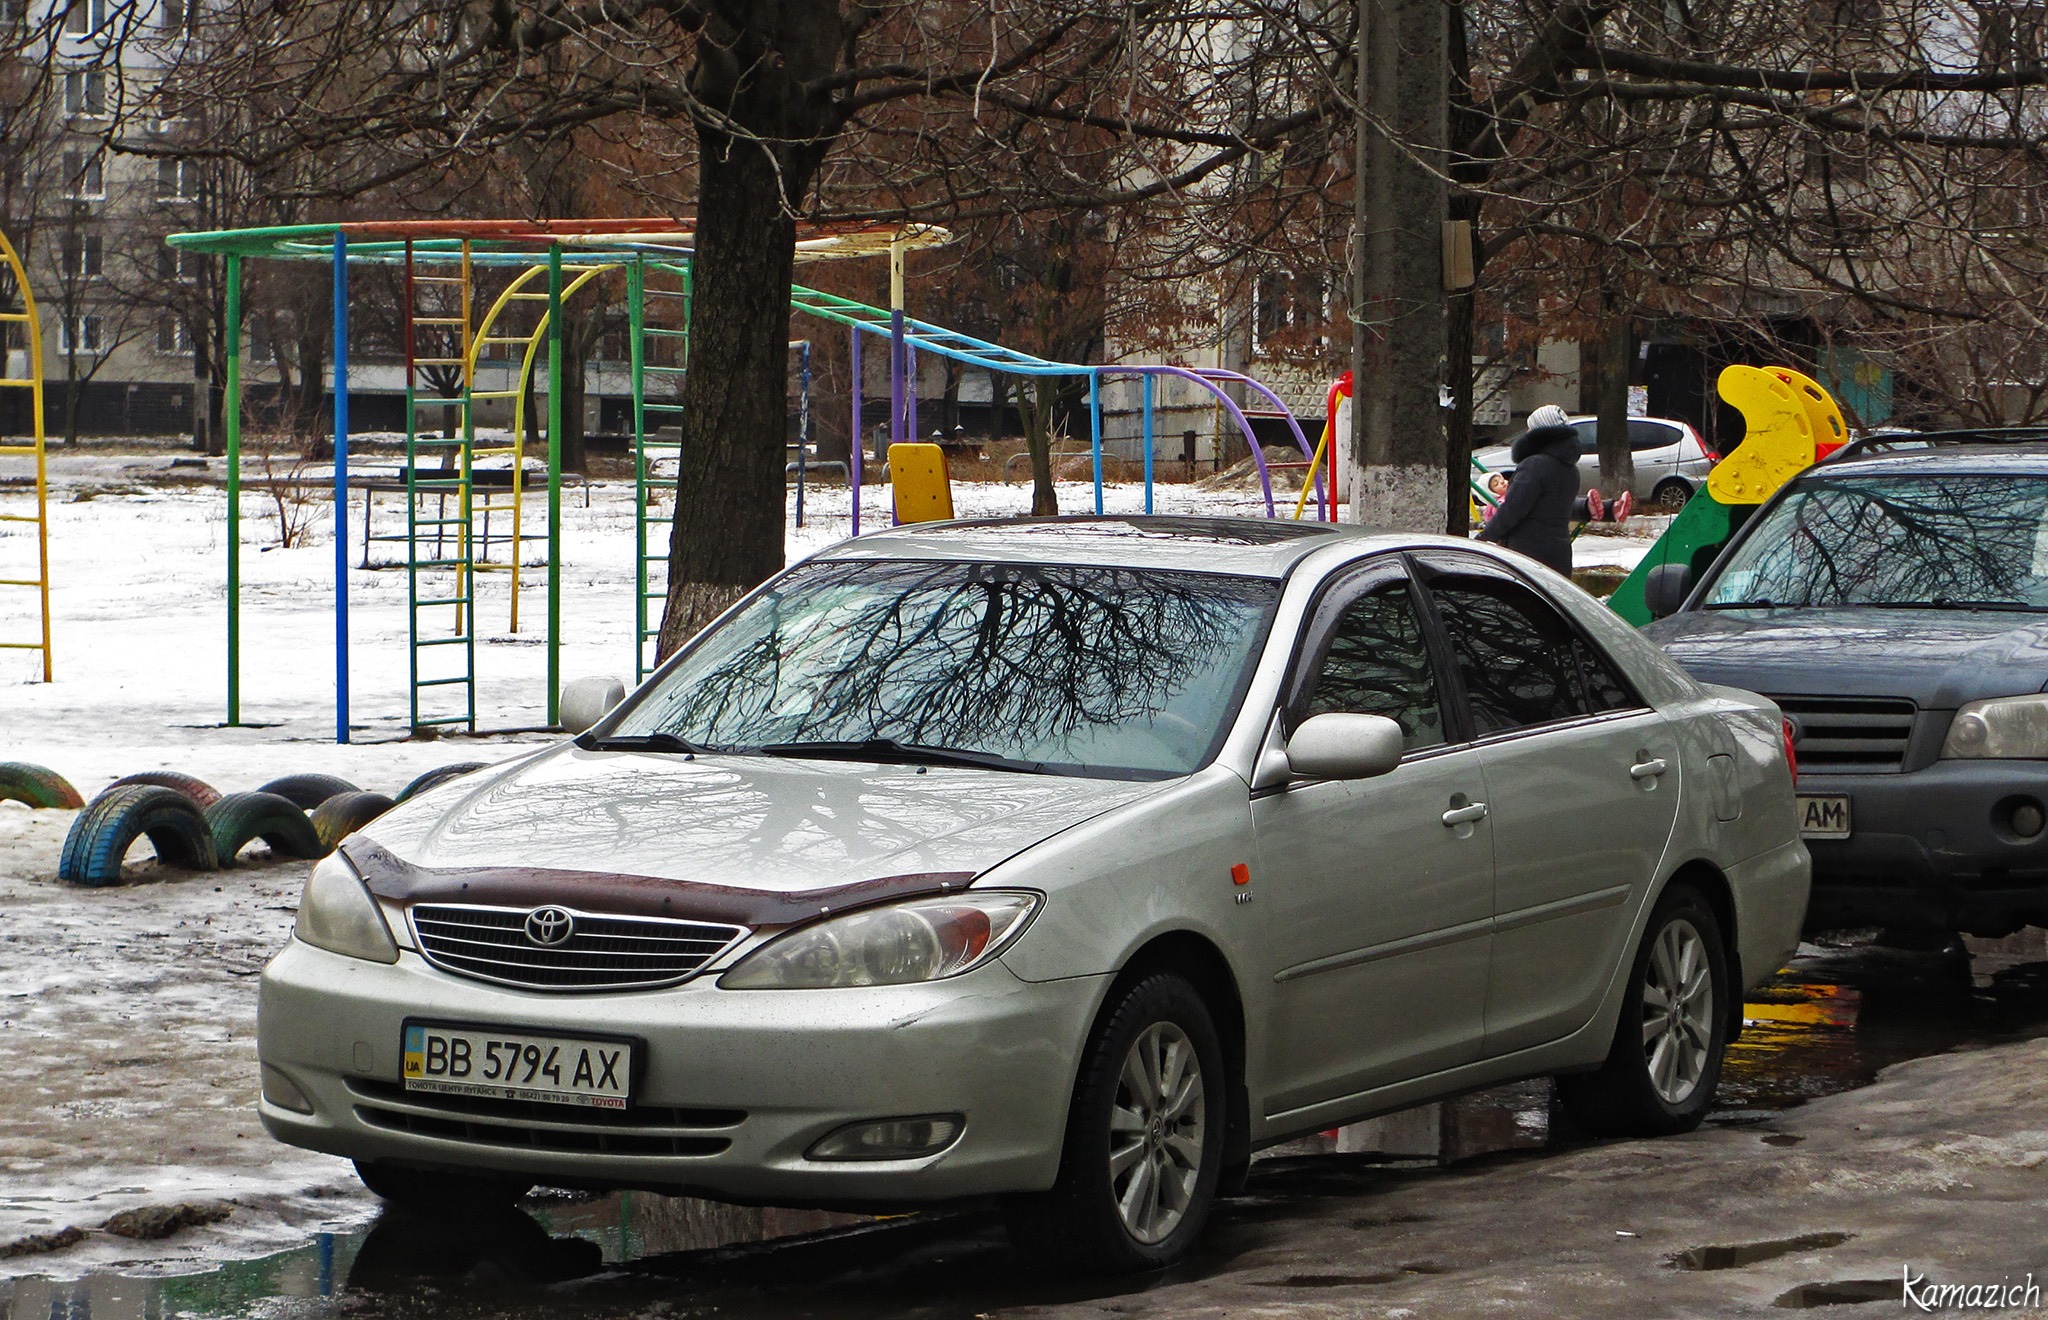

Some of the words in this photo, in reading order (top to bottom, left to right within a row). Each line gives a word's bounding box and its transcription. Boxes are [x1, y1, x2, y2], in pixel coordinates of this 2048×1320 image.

[1804, 801, 1842, 827] AM
[406, 1061, 421, 1073] UA
[426, 1036, 472, 1076] BB
[483, 1041, 560, 1085] 5794
[572, 1048, 620, 1089] AX
[438, 1083, 461, 1093] ЦЕНТР
[591, 1097, 625, 1108] TOYOTA
